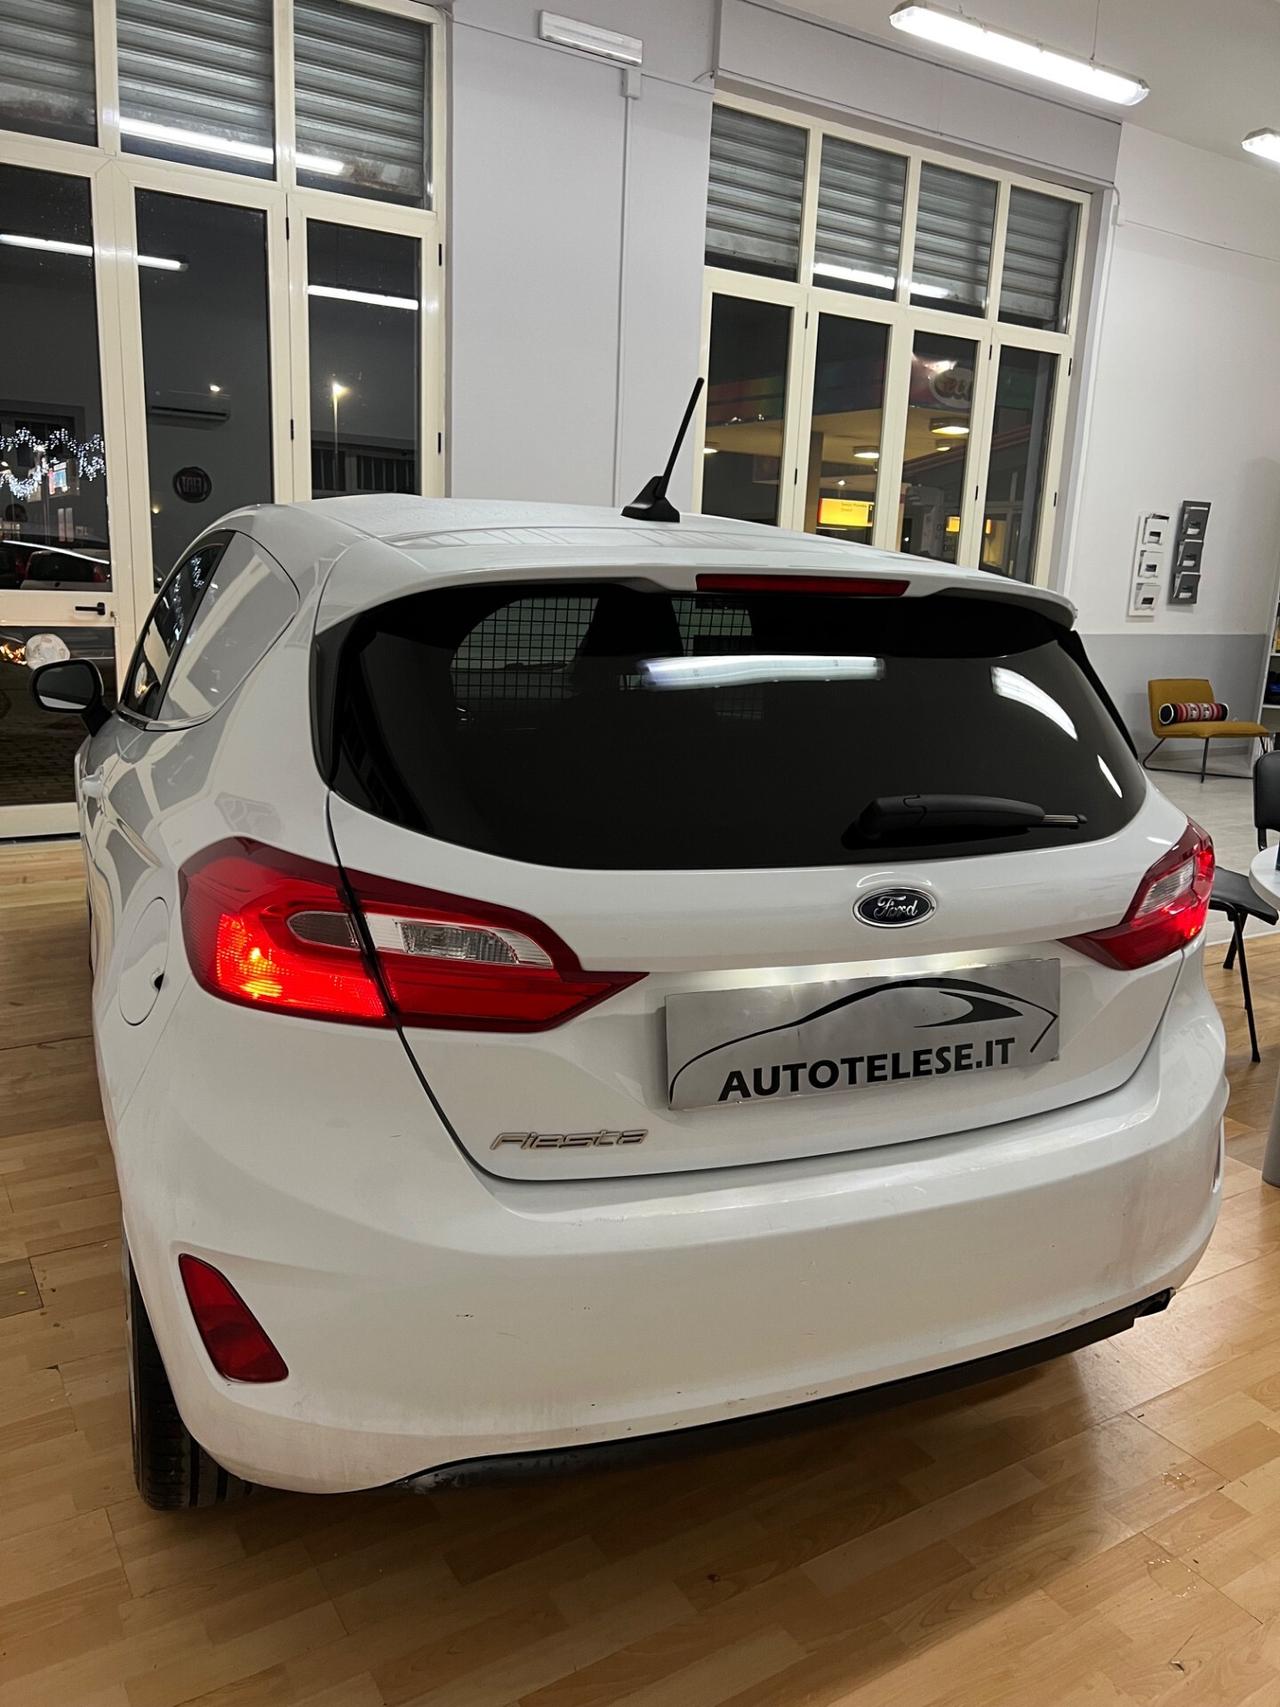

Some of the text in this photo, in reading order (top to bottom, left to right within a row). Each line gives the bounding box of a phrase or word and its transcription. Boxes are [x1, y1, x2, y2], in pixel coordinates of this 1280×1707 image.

[873, 895, 919, 920] Ford
[717, 1037, 1016, 1102] AUTOTELESE.IT
[489, 1128, 649, 1151] Fiesta
